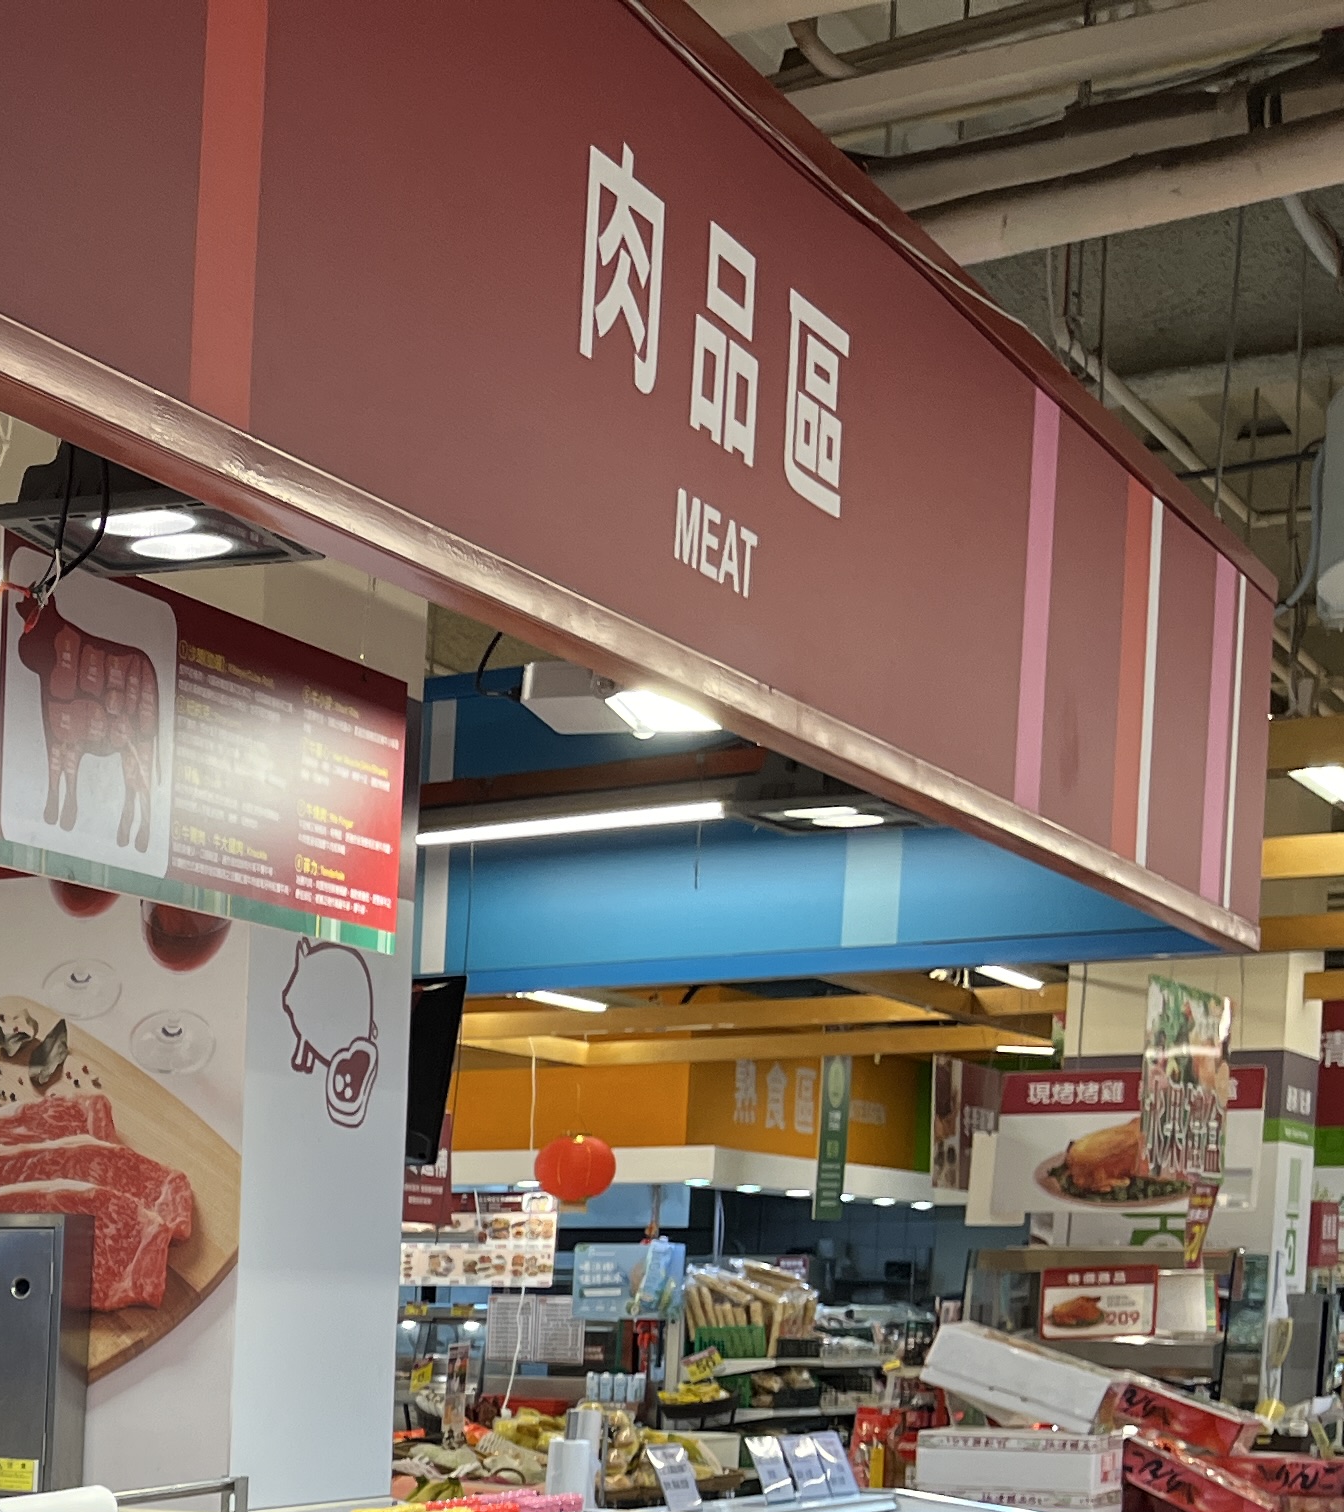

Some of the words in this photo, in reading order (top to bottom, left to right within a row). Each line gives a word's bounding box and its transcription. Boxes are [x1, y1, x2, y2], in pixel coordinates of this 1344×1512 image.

[580, 141, 850, 518] 肉品區
[674, 488, 758, 599] MEAT
